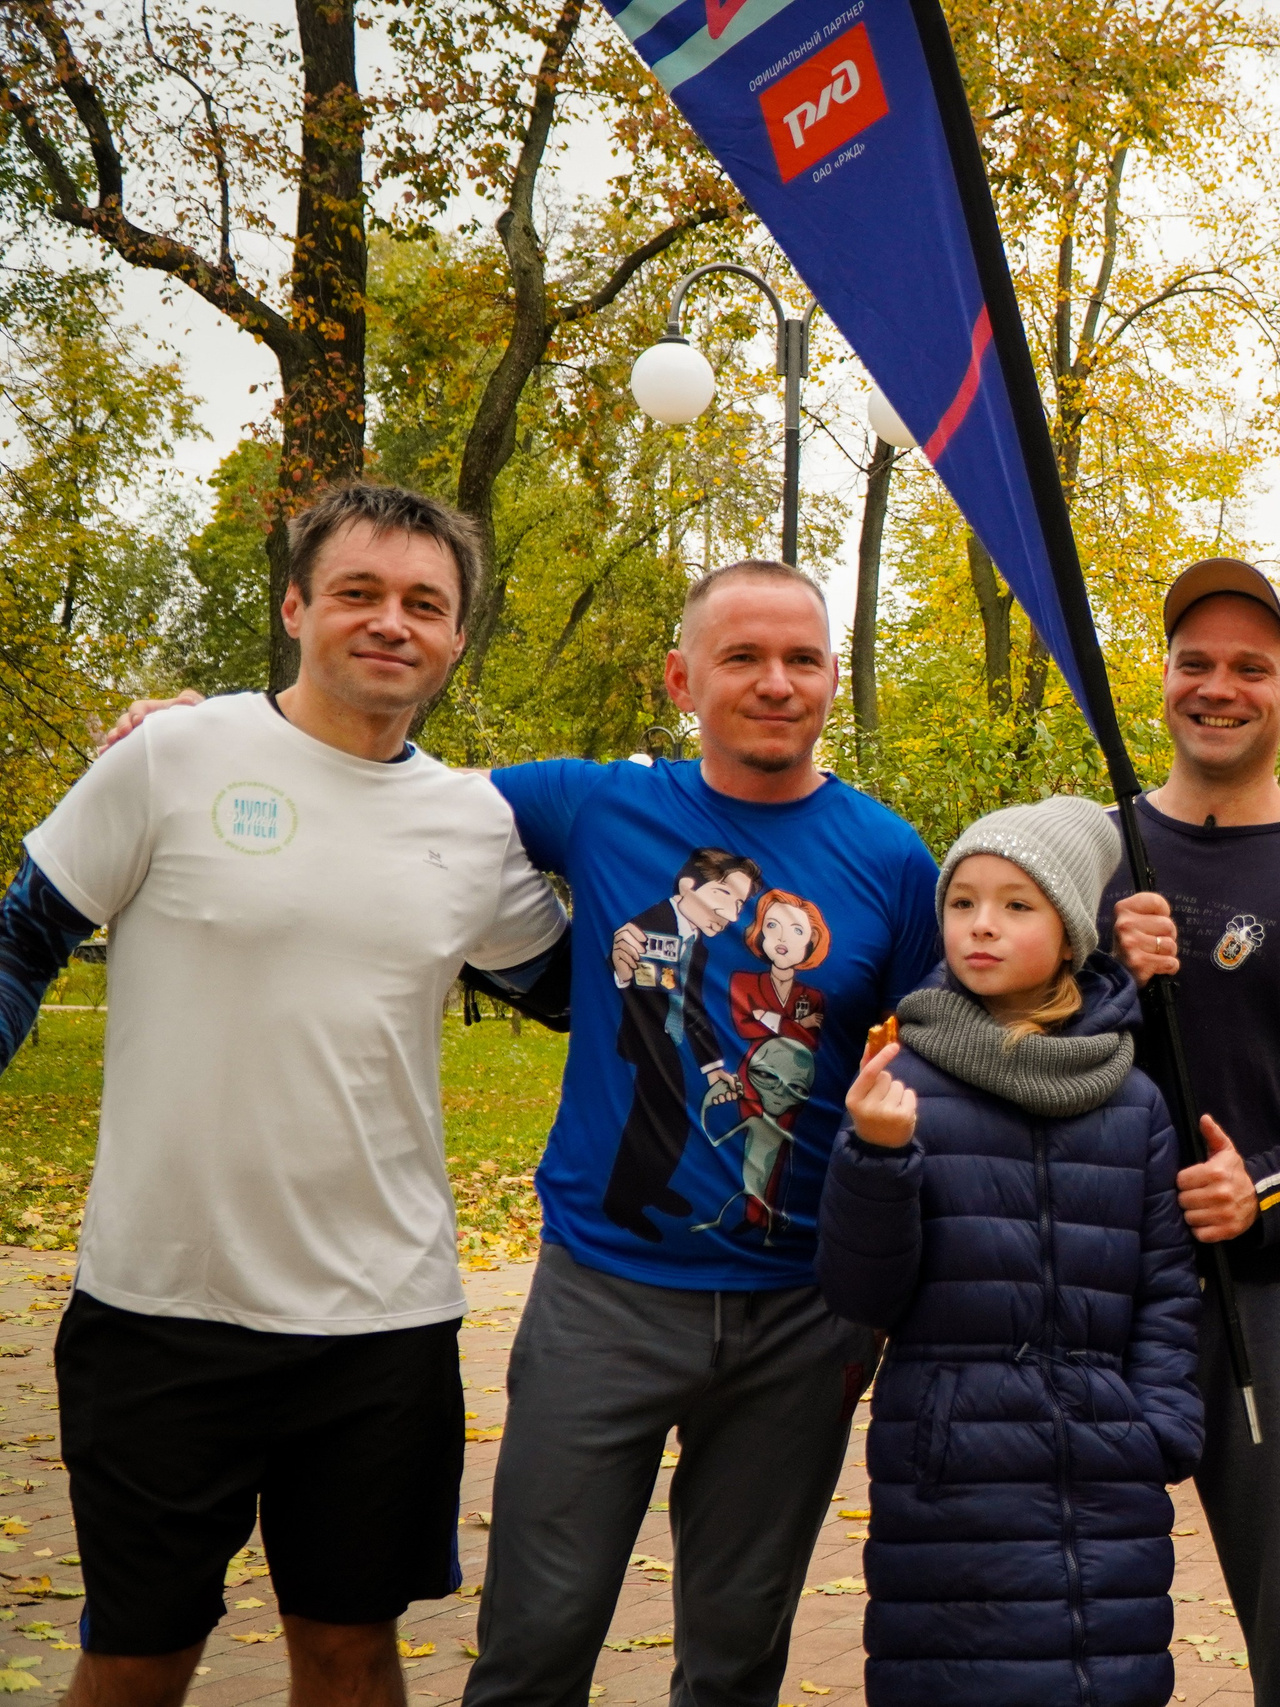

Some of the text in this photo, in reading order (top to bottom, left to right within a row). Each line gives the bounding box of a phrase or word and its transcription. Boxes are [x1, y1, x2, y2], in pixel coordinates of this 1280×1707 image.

[749, 1, 865, 92] ОФИЦИАЛЬНЫЙ ПАРТНЕР
[812, 163, 832, 183] ОАО
